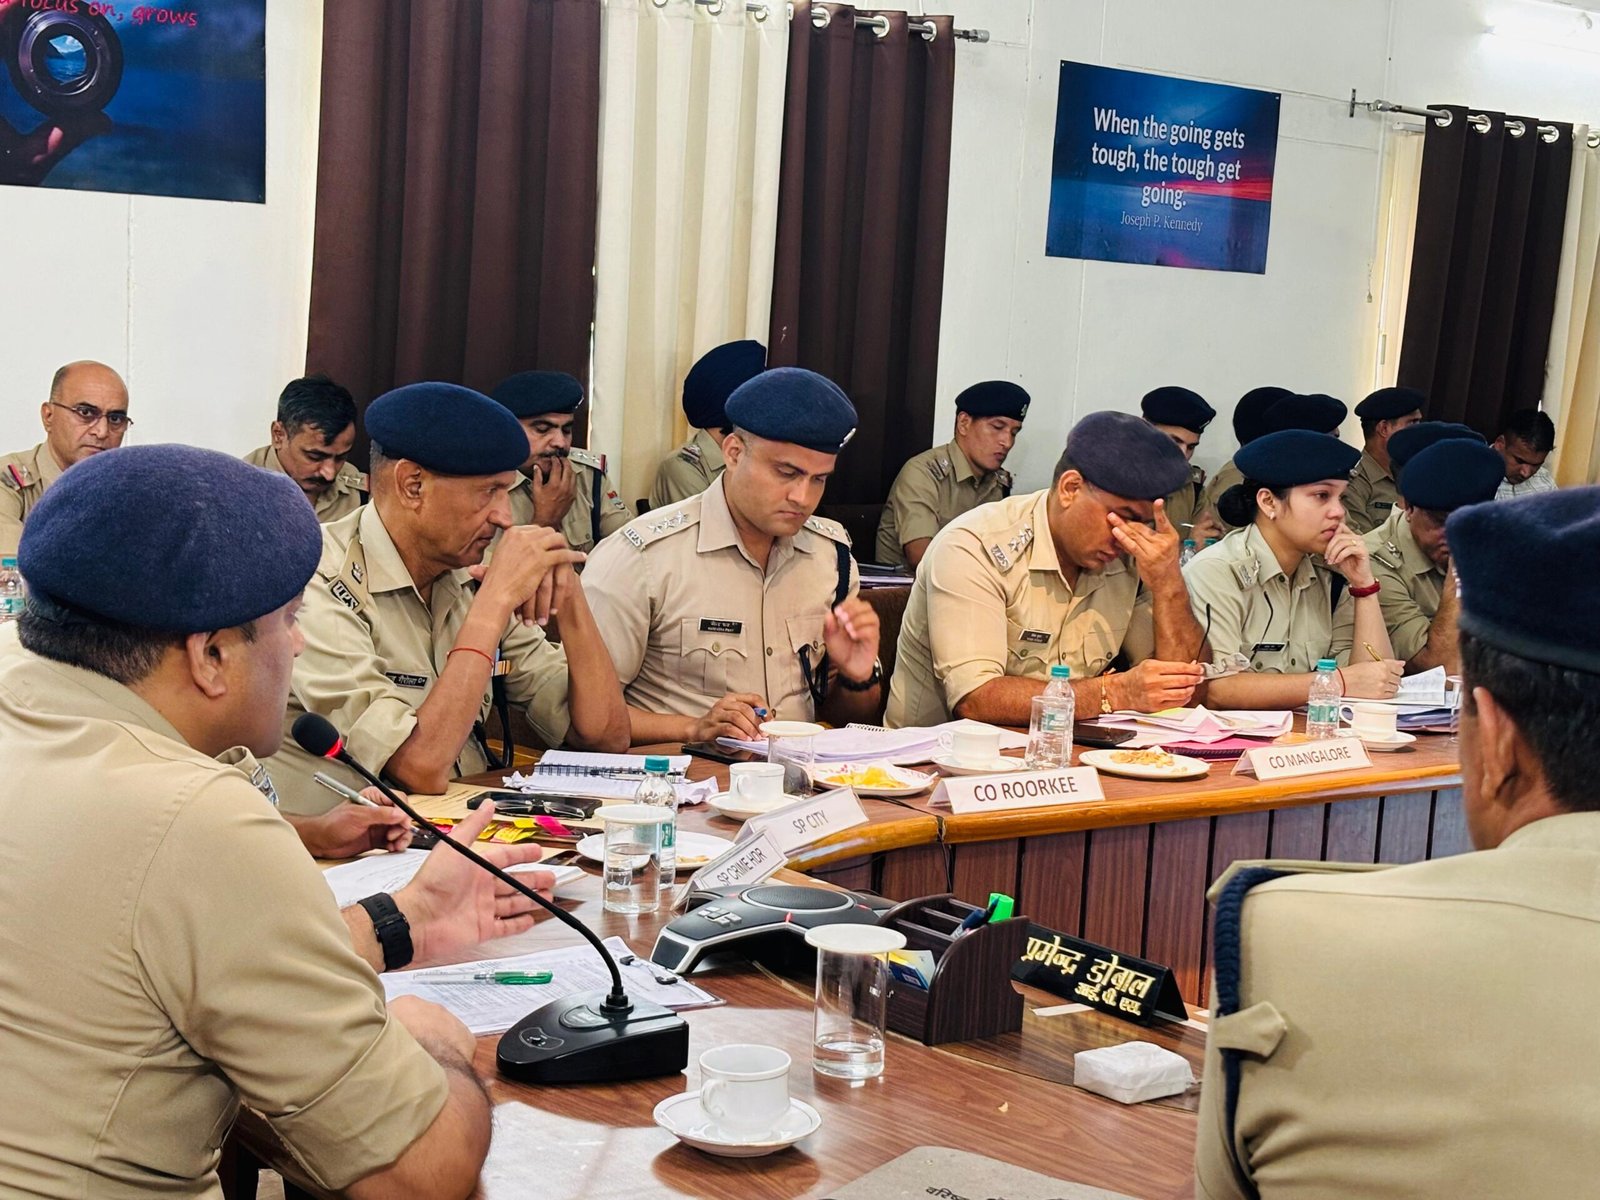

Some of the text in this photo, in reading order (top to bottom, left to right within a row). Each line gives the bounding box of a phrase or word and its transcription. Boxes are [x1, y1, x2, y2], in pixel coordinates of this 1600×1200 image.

[88, 1, 124, 21] on,
[132, 5, 198, 27] grows
[1093, 106, 1245, 151] When the going gets
[1092, 142, 1241, 183] tough, the tough get
[1141, 181, 1186, 210] going.
[1120, 211, 1203, 236] Joseph P. Kennedy
[1269, 747, 1352, 769] CO MANGALORE
[974, 775, 1079, 802] CO ROORKEE
[792, 809, 829, 834] SP CITY
[717, 847, 768, 887] SP CRIME HDR
